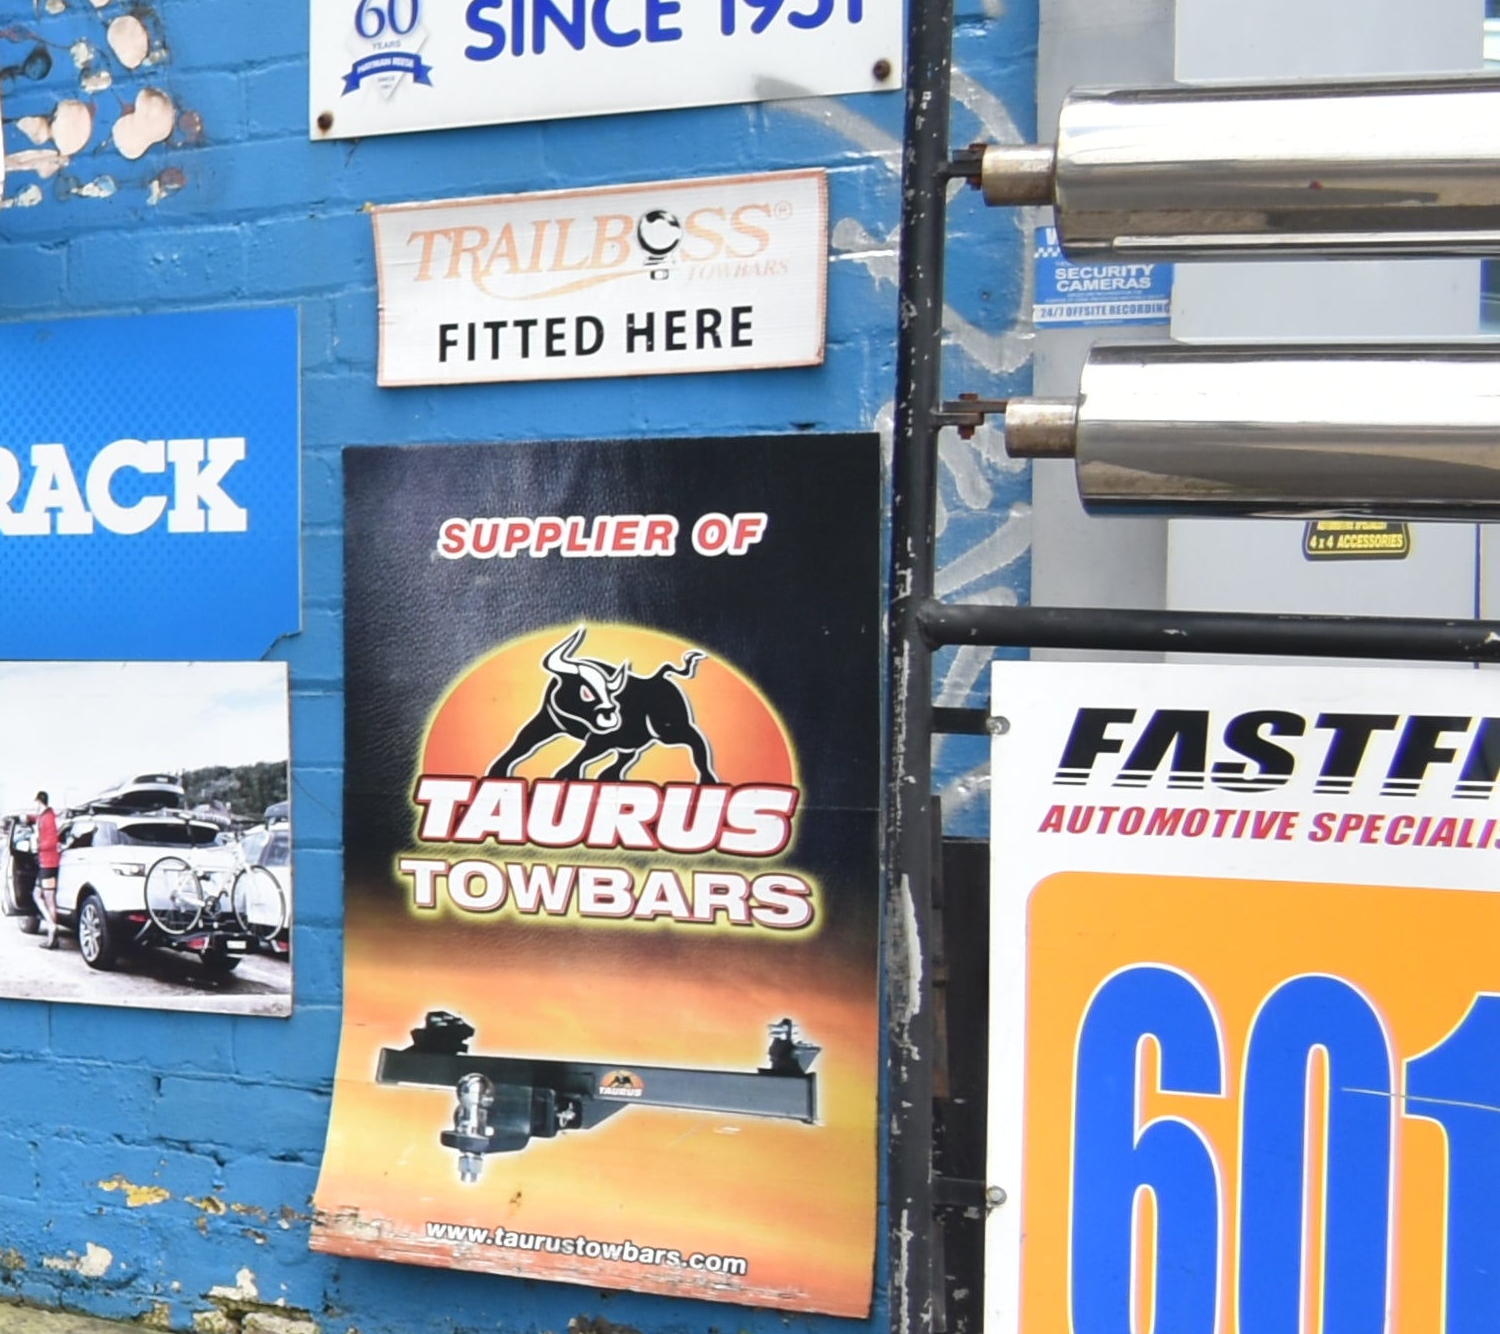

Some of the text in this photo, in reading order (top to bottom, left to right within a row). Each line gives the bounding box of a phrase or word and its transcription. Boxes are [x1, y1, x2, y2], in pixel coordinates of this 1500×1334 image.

[687, 257, 790, 285] TOWBARS
[1055, 263, 1157, 280] SECURITY
[1056, 276, 1152, 293] CAMERAS
[1065, 305, 1107, 317] OFFSITE
[1109, 303, 1170, 316] RECORDING
[438, 305, 754, 363] FITTED HERE
[438, 513, 768, 559] SUPPLIER OF
[1336, 533, 1404, 549] ACCESSORIES
[416, 775, 800, 858] TAURUS
[1037, 804, 1500, 849] AUTOMOTIVE SPECIALI
[399, 858, 814, 928] TOWBARS
[599, 1085, 644, 1098] TAURUS
[426, 1220, 748, 1276] www.taurustowbars.com
